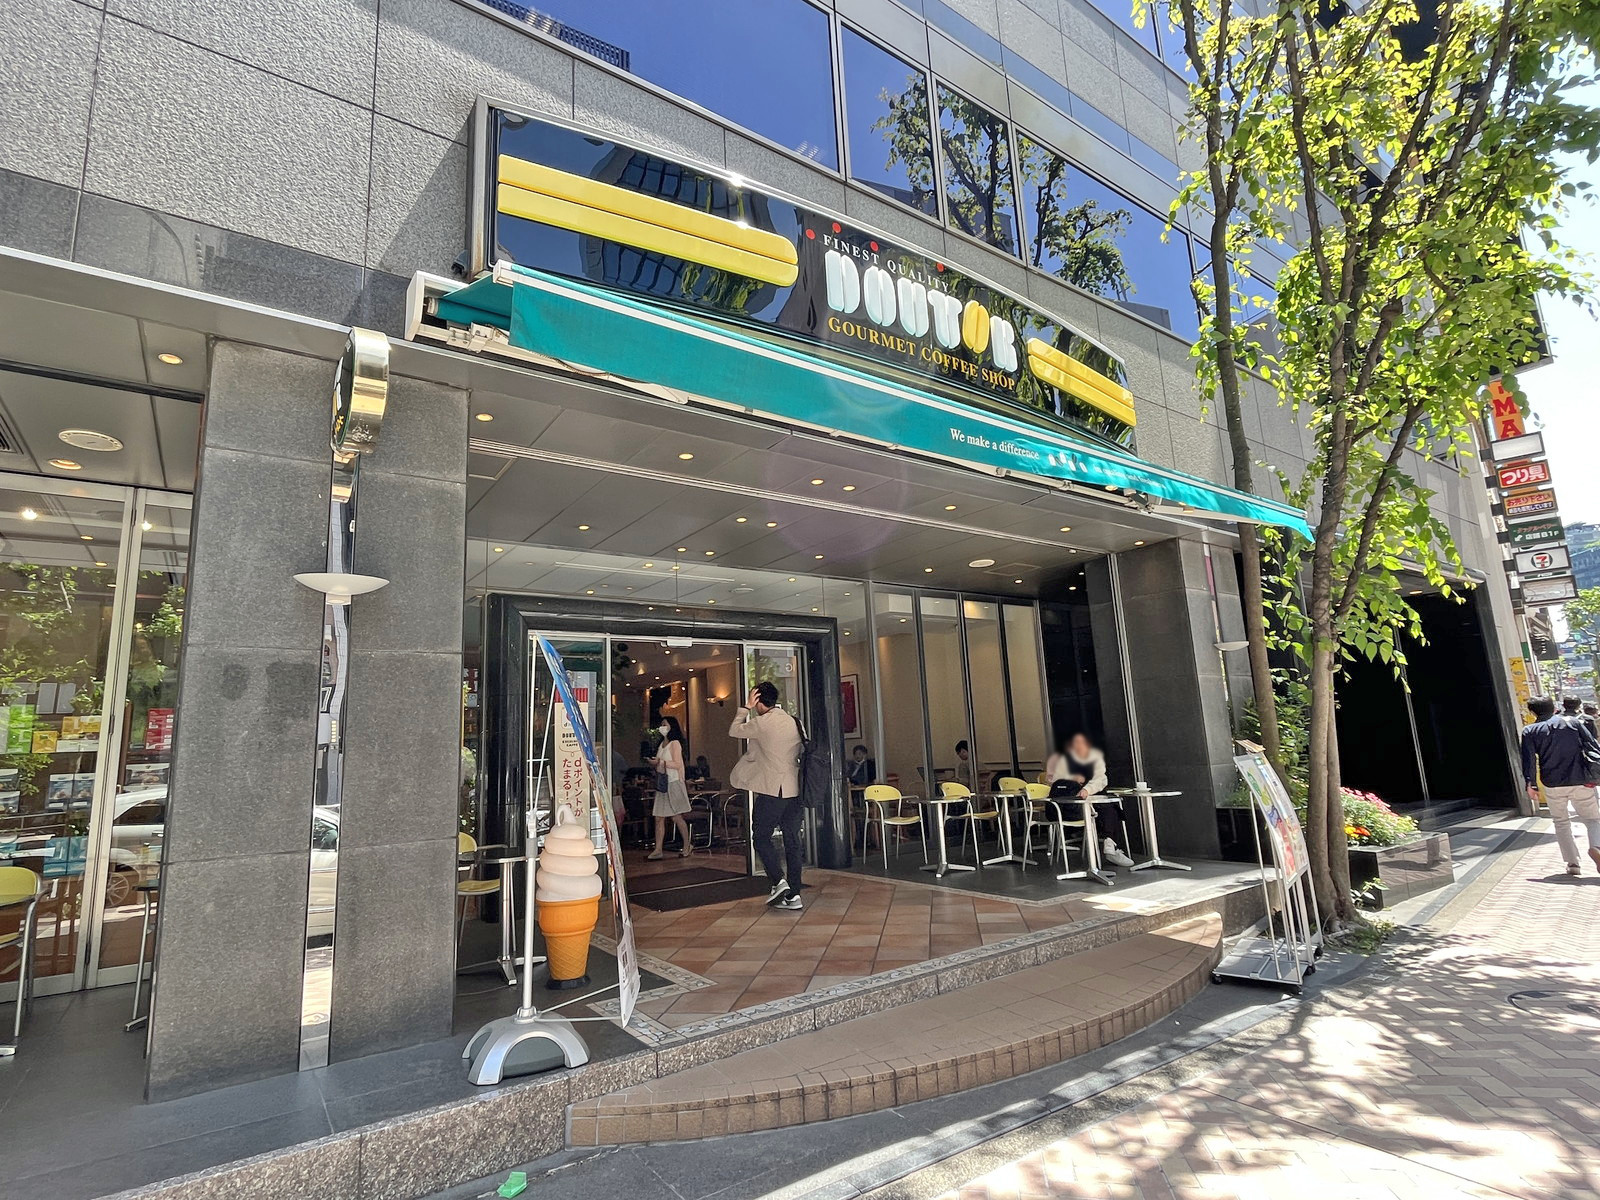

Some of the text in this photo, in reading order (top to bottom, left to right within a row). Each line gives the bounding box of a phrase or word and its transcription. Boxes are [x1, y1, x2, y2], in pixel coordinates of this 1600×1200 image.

[823, 234, 949, 292] FINEST QUALITY
[825, 249, 1018, 373] DOUTOR
[828, 316, 1015, 391] GOURMET COFFEE SHOP
[950, 428, 1040, 460] We make a difference
[1501, 464, 1545, 485] つり具
[574, 757, 583, 817] dポイントが
